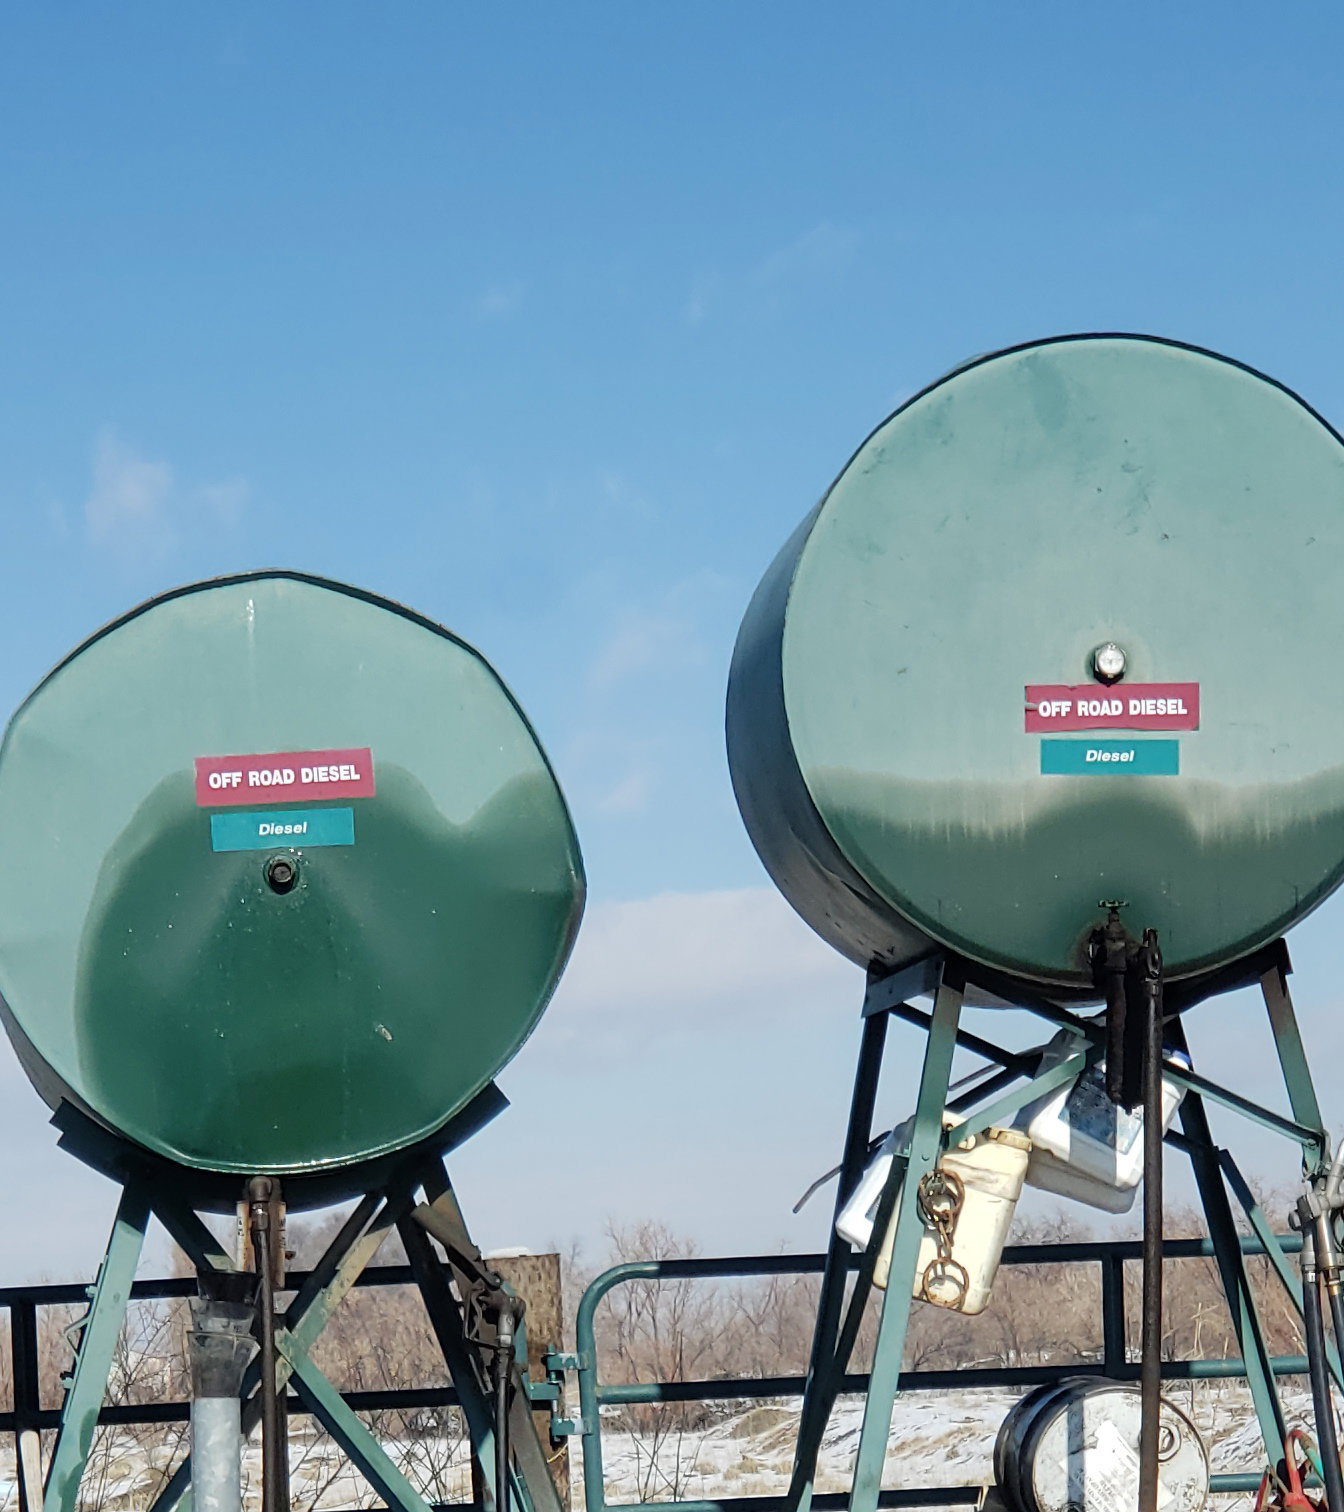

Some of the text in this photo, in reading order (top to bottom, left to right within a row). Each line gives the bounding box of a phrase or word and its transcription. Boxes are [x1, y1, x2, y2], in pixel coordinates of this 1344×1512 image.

[1038, 698, 1188, 718] OFF ROAD DIESEL
[1085, 749, 1135, 763] Diesel
[208, 764, 361, 789] OFF ROAD DIESEL
[258, 821, 308, 836] Diesel
